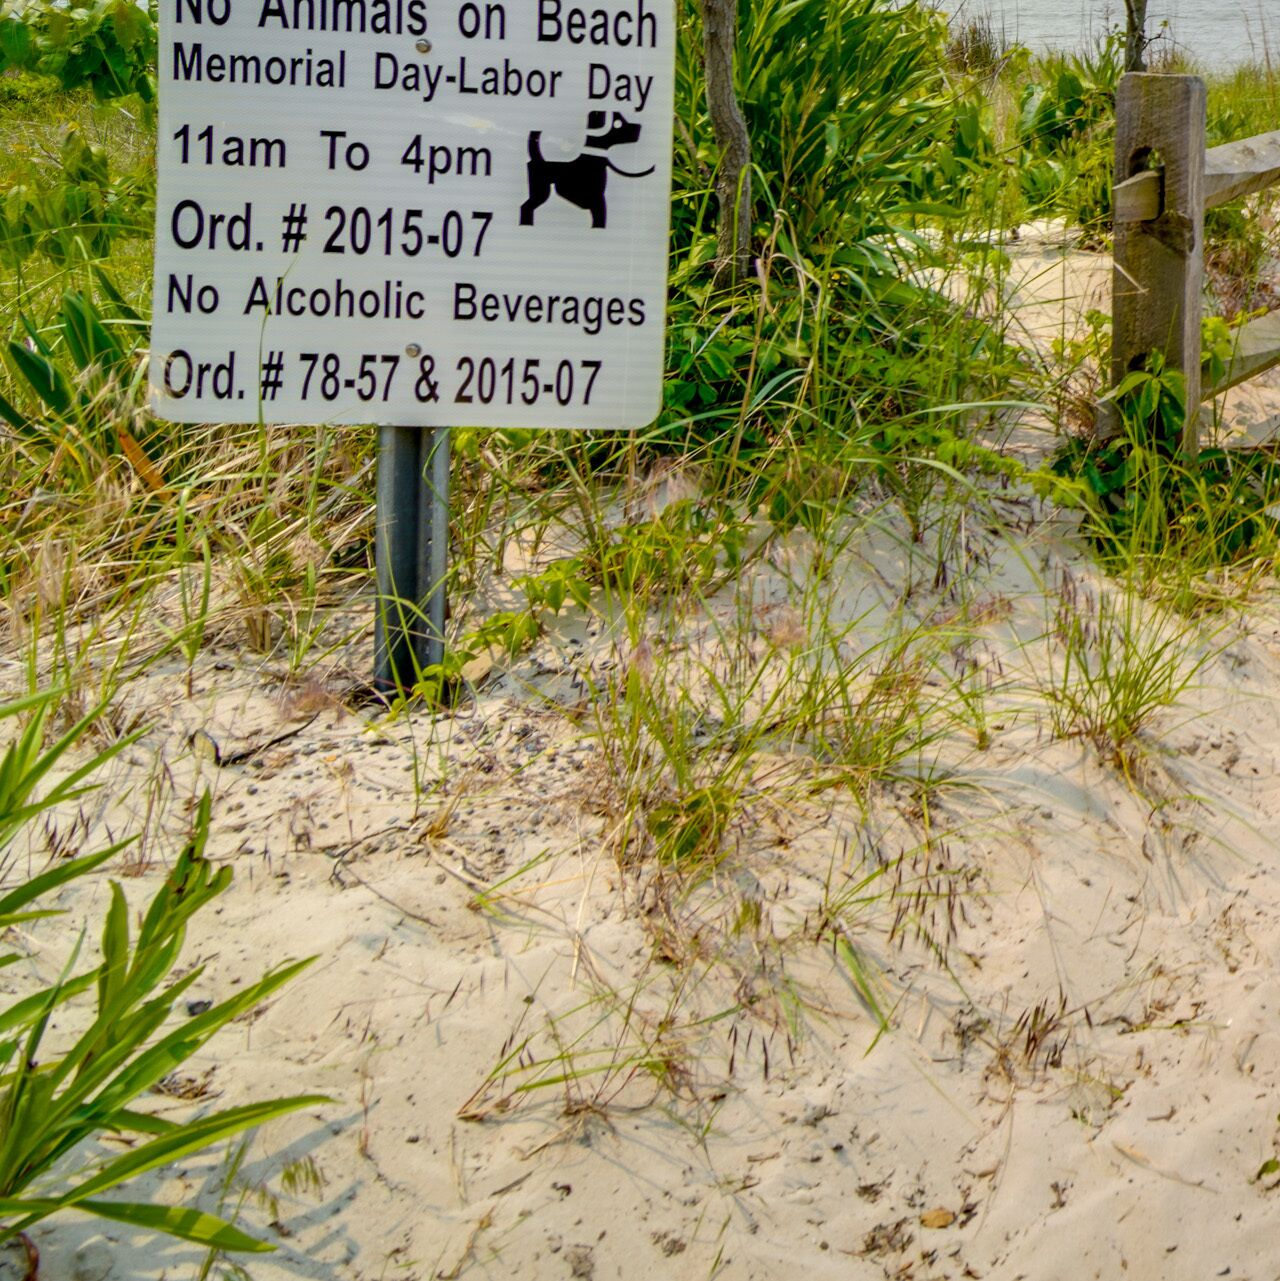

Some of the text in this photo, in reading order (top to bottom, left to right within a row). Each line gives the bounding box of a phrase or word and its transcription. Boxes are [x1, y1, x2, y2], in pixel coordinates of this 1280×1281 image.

[459, 1, 506, 40] on
[173, 42, 653, 112] Memorial Day-Labor Day
[173, 124, 493, 184] 11am To 4pm
[170, 200, 493, 257] Ord. # 2015-07
[167, 273, 646, 336] No Alcoholic Beverages
[163, 349, 602, 406] Ord. # 78-57 & 2015-07
